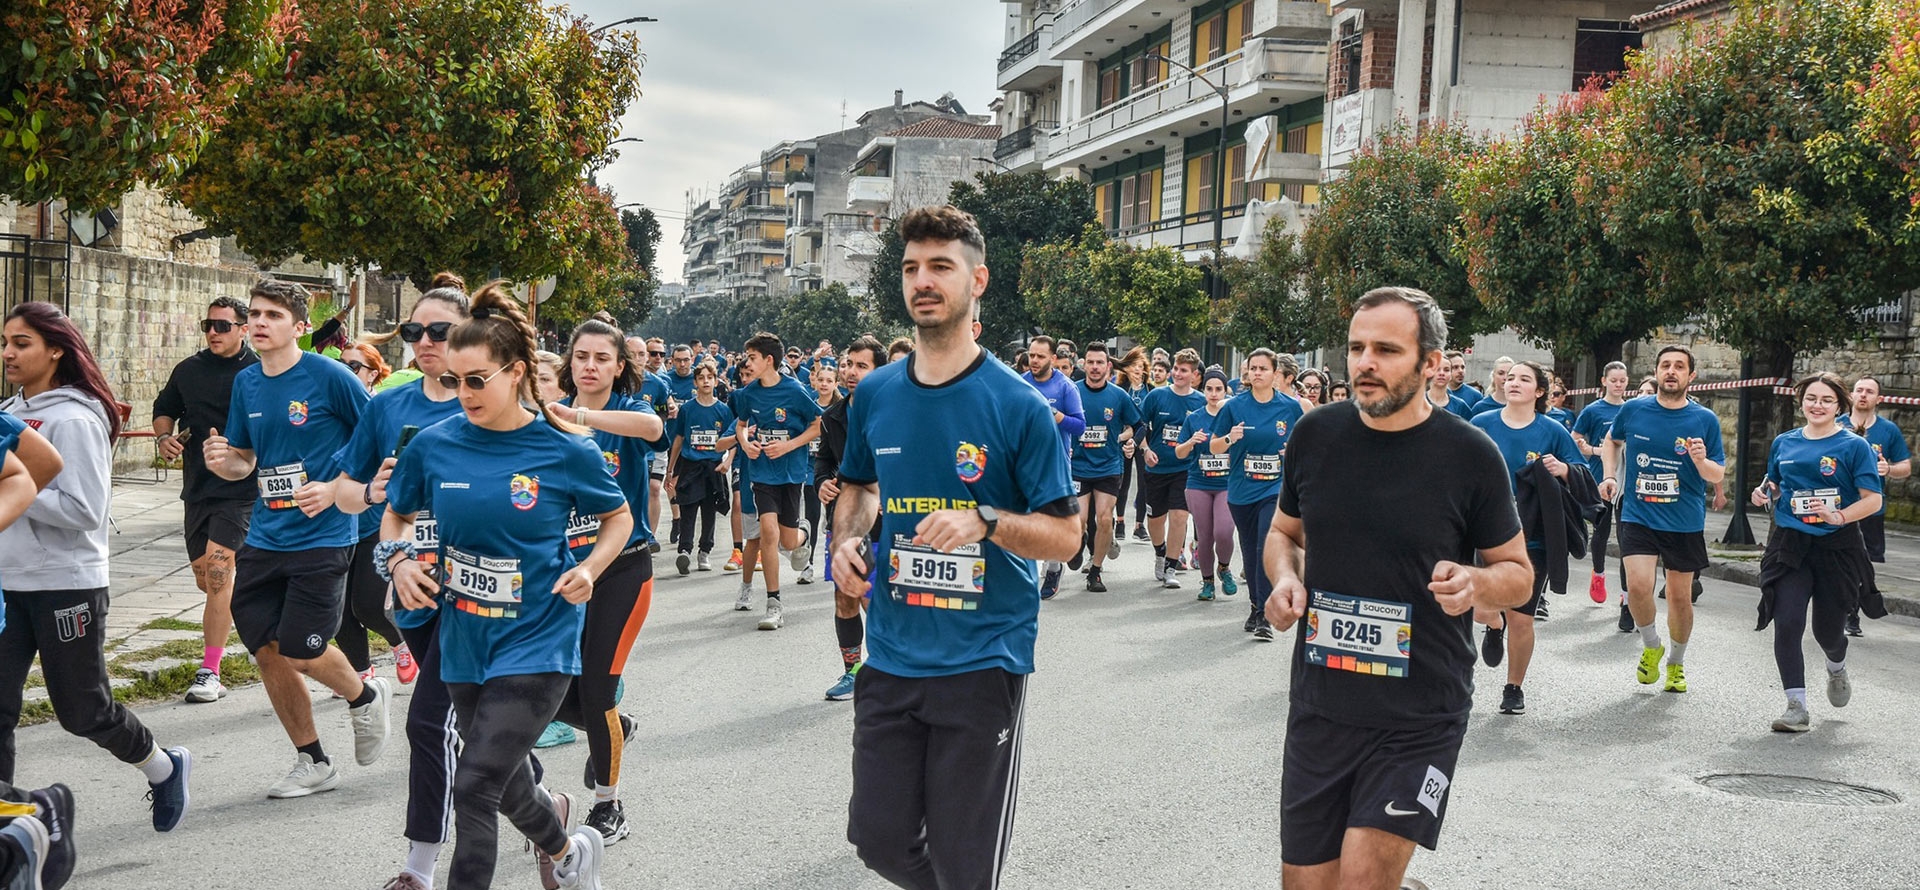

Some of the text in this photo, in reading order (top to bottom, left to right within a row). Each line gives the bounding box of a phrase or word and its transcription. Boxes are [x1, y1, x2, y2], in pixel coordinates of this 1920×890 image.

[1207, 460, 1223, 468] 5134
[1253, 461, 1273, 470] 6305
[267, 478, 293, 492] 6334
[1644, 481, 1668, 491] 6006
[415, 524, 439, 542] 519
[483, 558, 514, 569] saucony
[912, 558, 957, 582] 5915
[460, 568, 498, 594] 5193
[1363, 602, 1403, 617] saucony
[56, 610, 92, 642] UP
[1331, 618, 1382, 646] 6245
[1424, 777, 1444, 801] 624
